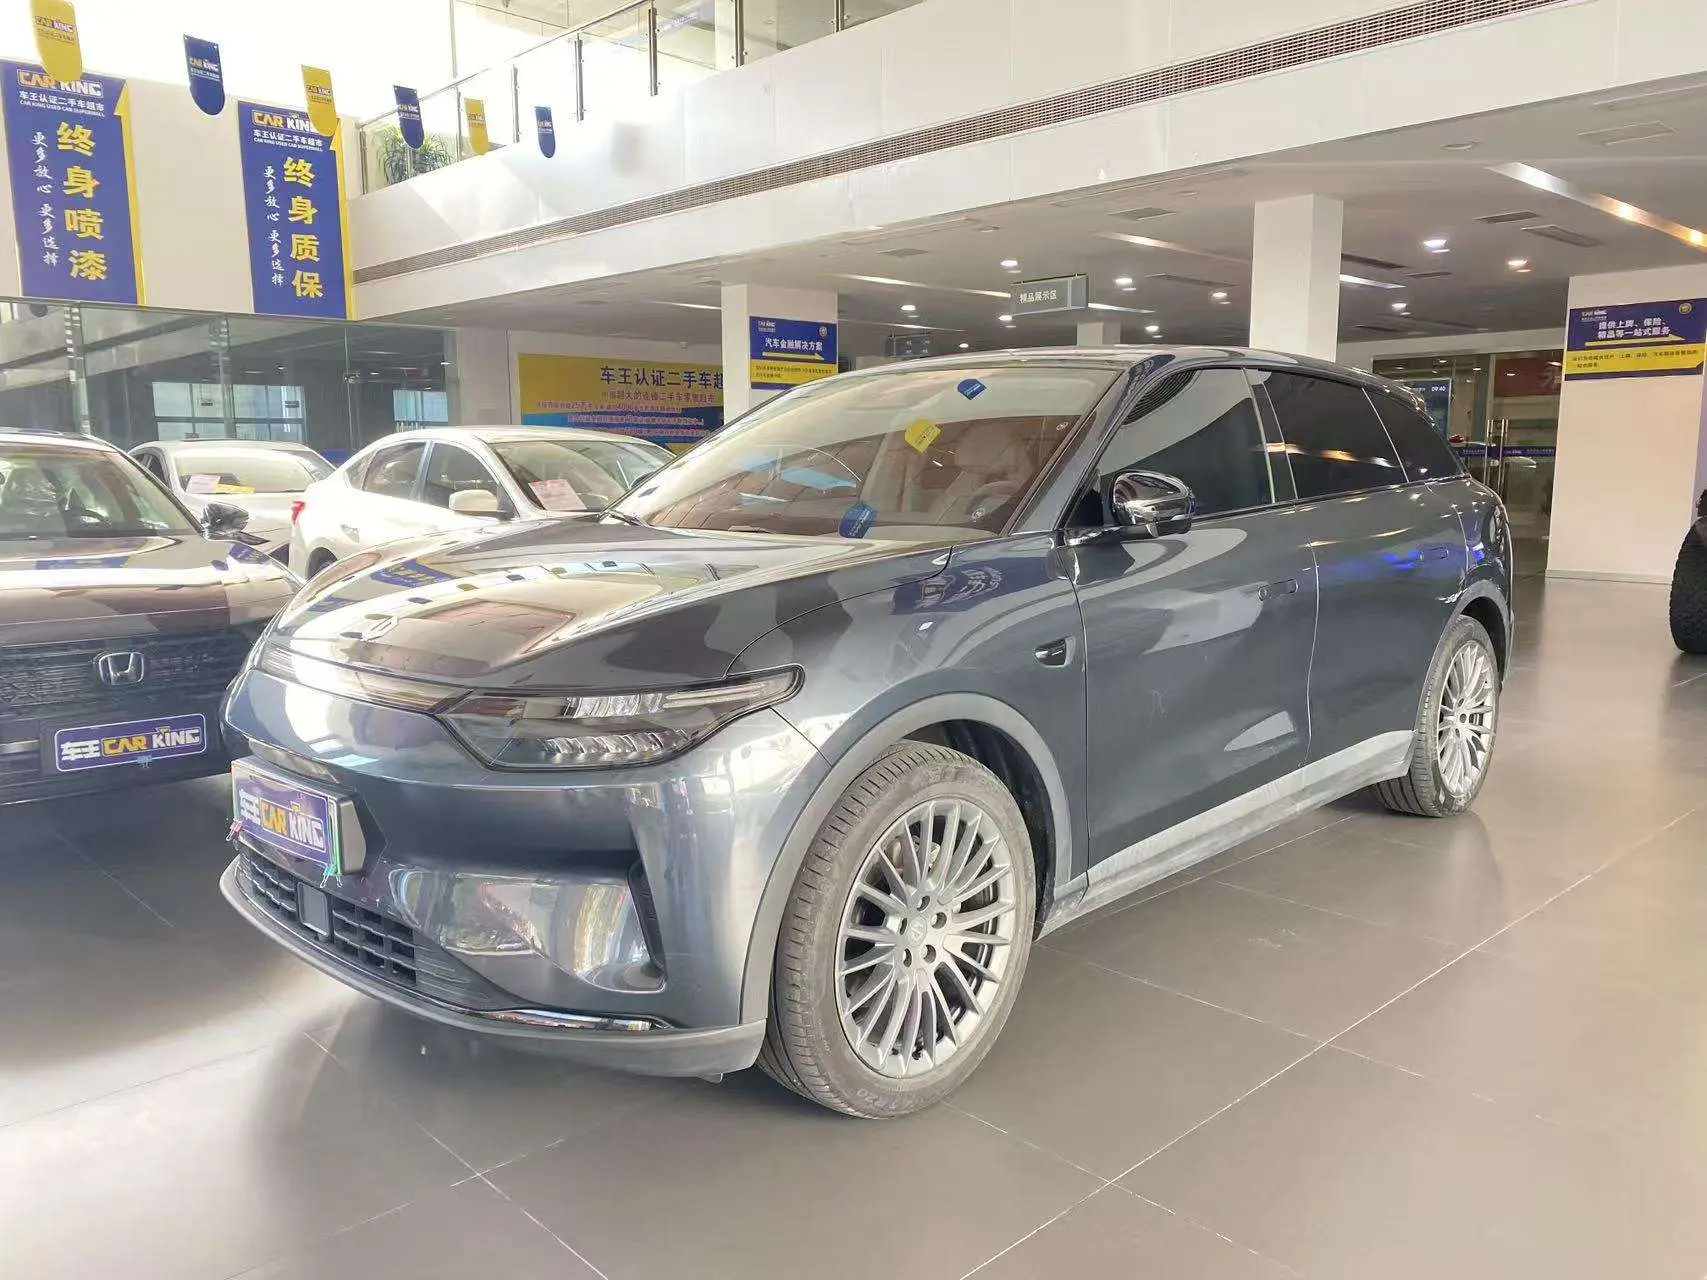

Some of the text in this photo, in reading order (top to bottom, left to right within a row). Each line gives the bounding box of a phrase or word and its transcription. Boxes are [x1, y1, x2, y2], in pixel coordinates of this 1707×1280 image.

[20, 71, 102, 97] CAR KING
[19, 90, 104, 112] 车王认证二手车超市
[253, 112, 318, 133] CAR KIN
[253, 129, 323, 147] 车王认证二手车超市
[31, 131, 60, 267] 更多放心 更多选择
[57, 121, 107, 280] 终身喷漆
[264, 165, 284, 286] 更多放心 更多选择
[283, 157, 324, 298] 终身质保
[1019, 289, 1057, 303] 精品展示区
[765, 337, 823, 351] 汽车金融解决方案
[1598, 327, 1670, 339] 精品等一站式服务
[103, 735, 148, 756] CAR
[152, 728, 200, 749] KING
[261, 802, 288, 836] CAR
[289, 811, 325, 850] KING
